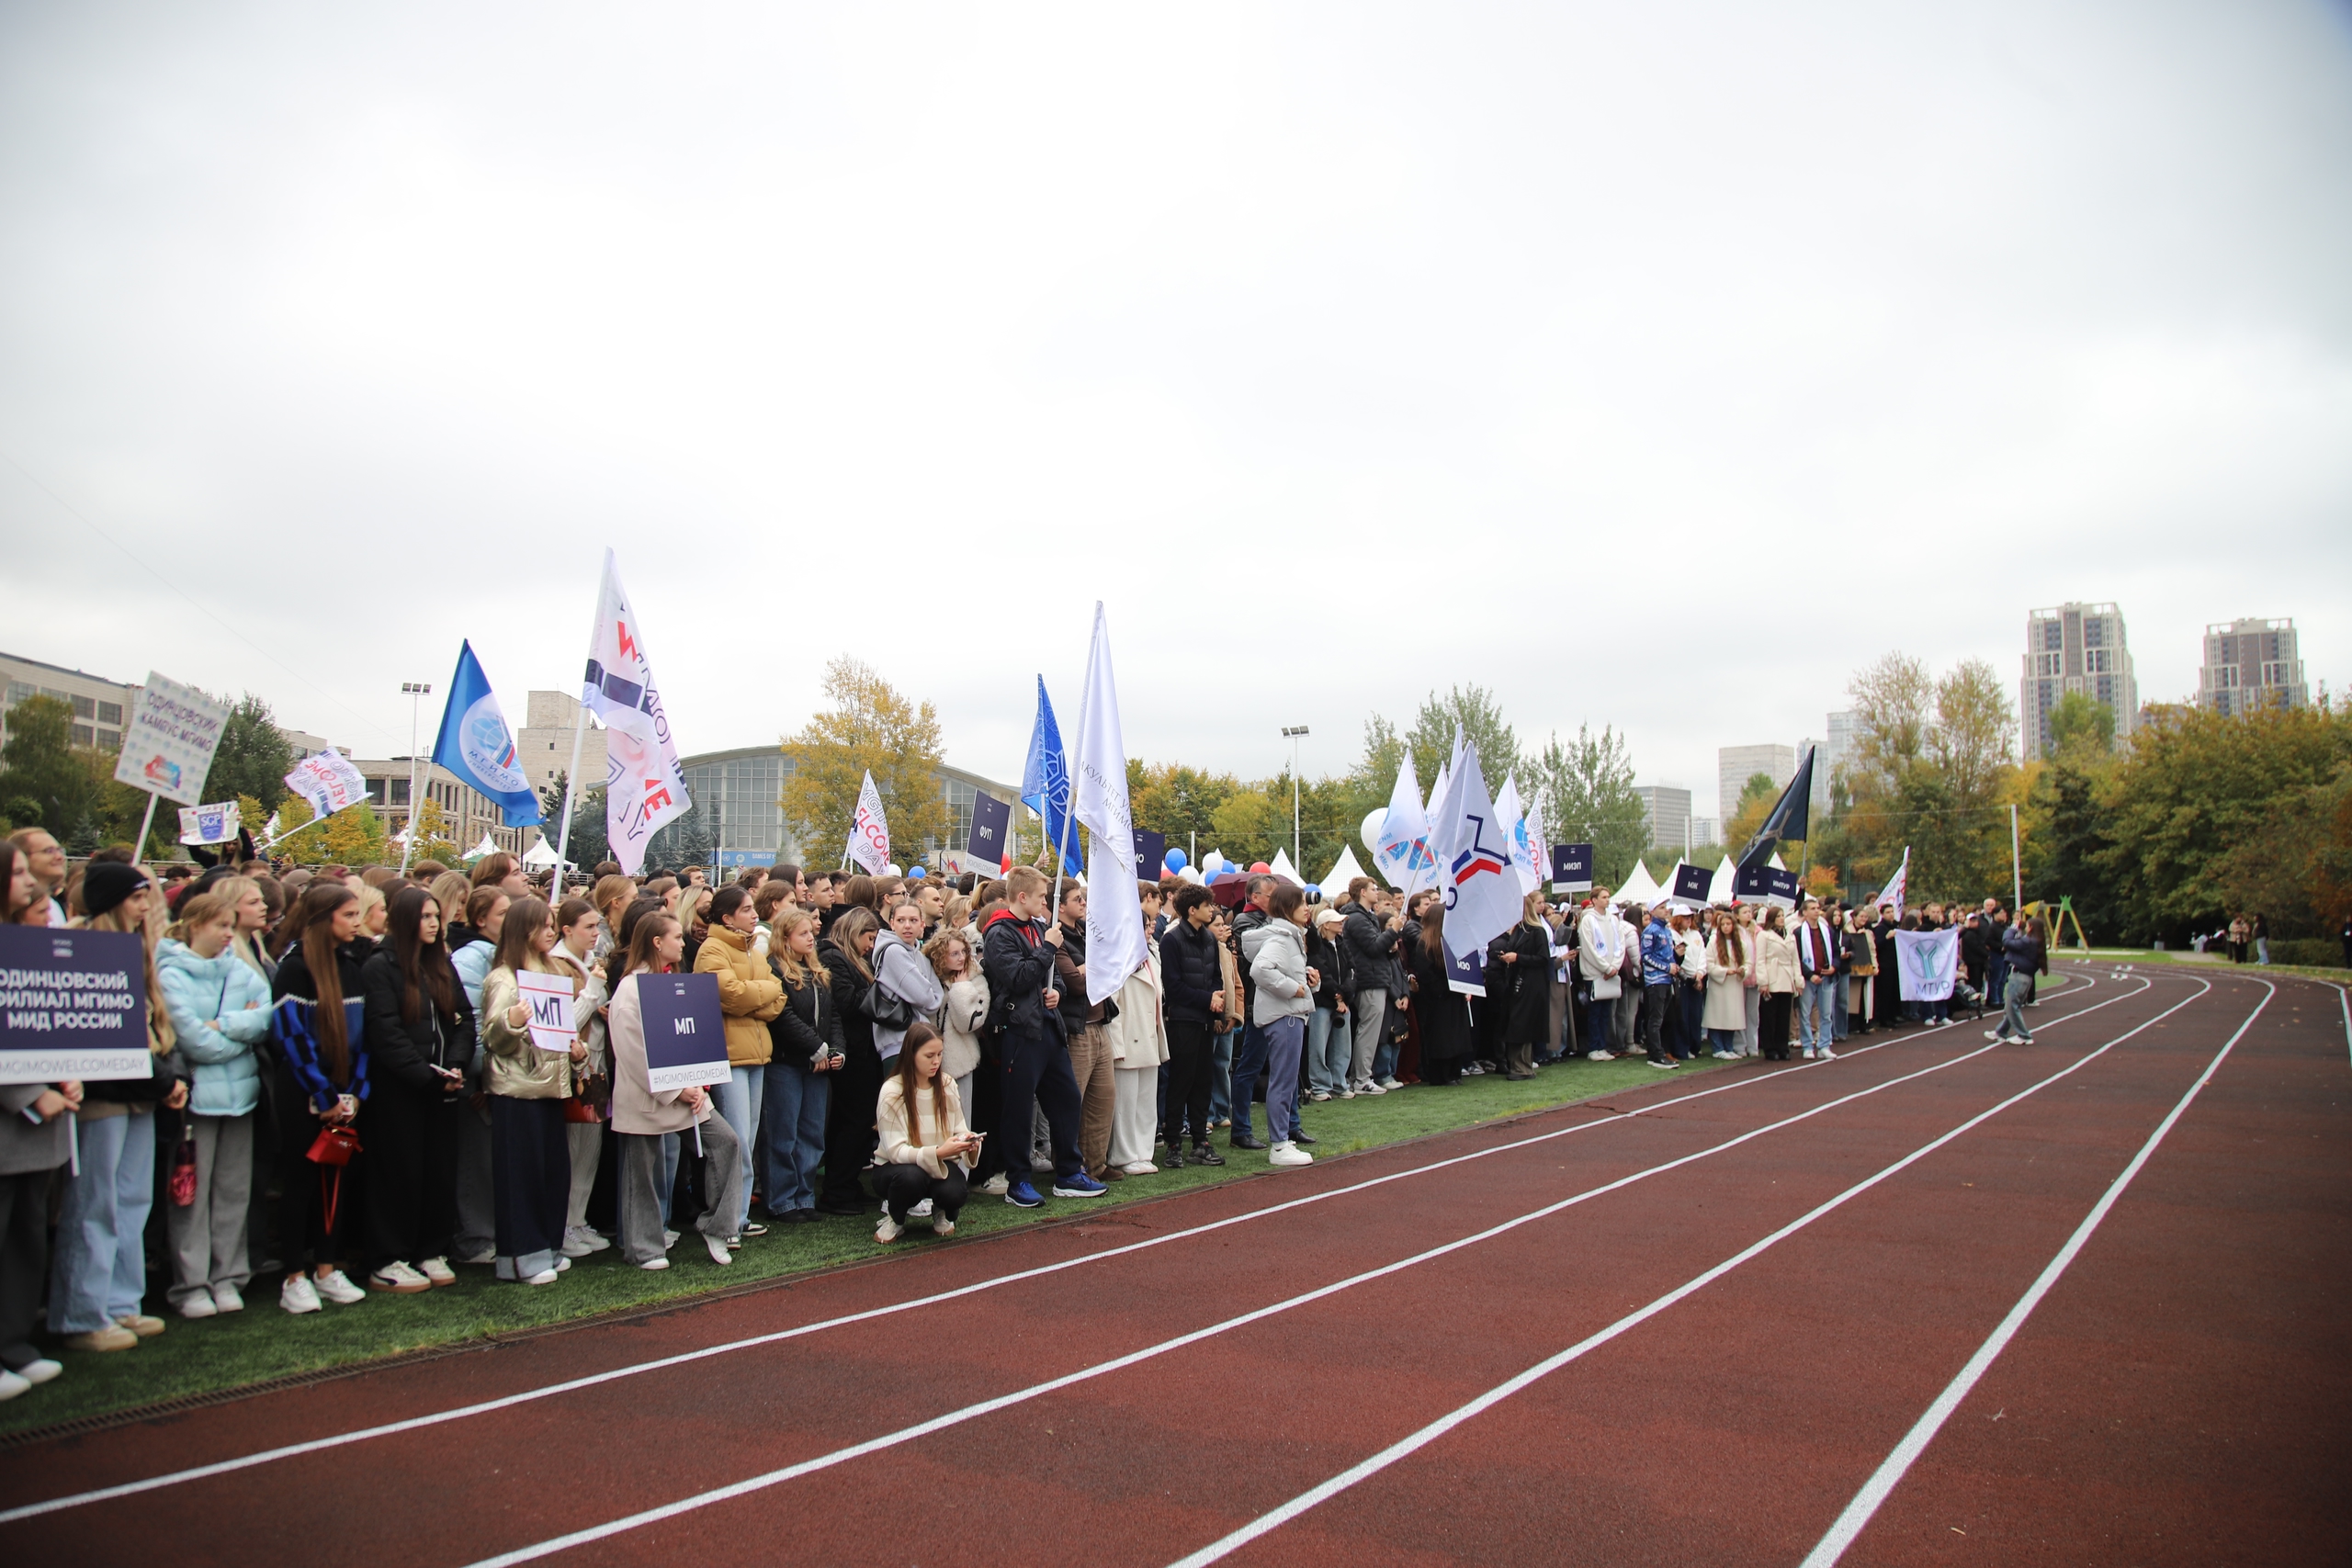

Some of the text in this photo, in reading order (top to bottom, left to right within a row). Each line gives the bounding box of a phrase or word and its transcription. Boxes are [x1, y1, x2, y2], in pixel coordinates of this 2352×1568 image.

[469, 750, 519, 786] МГИМО
[469, 759, 511, 790] УНИВЕРСИТЕТ
[979, 825, 992, 840] ФУП
[1564, 861, 1582, 871] МИЭП
[1687, 880, 1699, 890] МЖ
[0, 968, 130, 990] ОДИНЦОВСКИЙ
[74, 993, 135, 1010] МГИМО
[532, 995, 562, 1027] МП
[7, 1010, 123, 1032] МИД РОССИИ
[673, 1017, 695, 1035] МП
[653, 1066, 729, 1086] #MGIMOWELCOMEDAY
